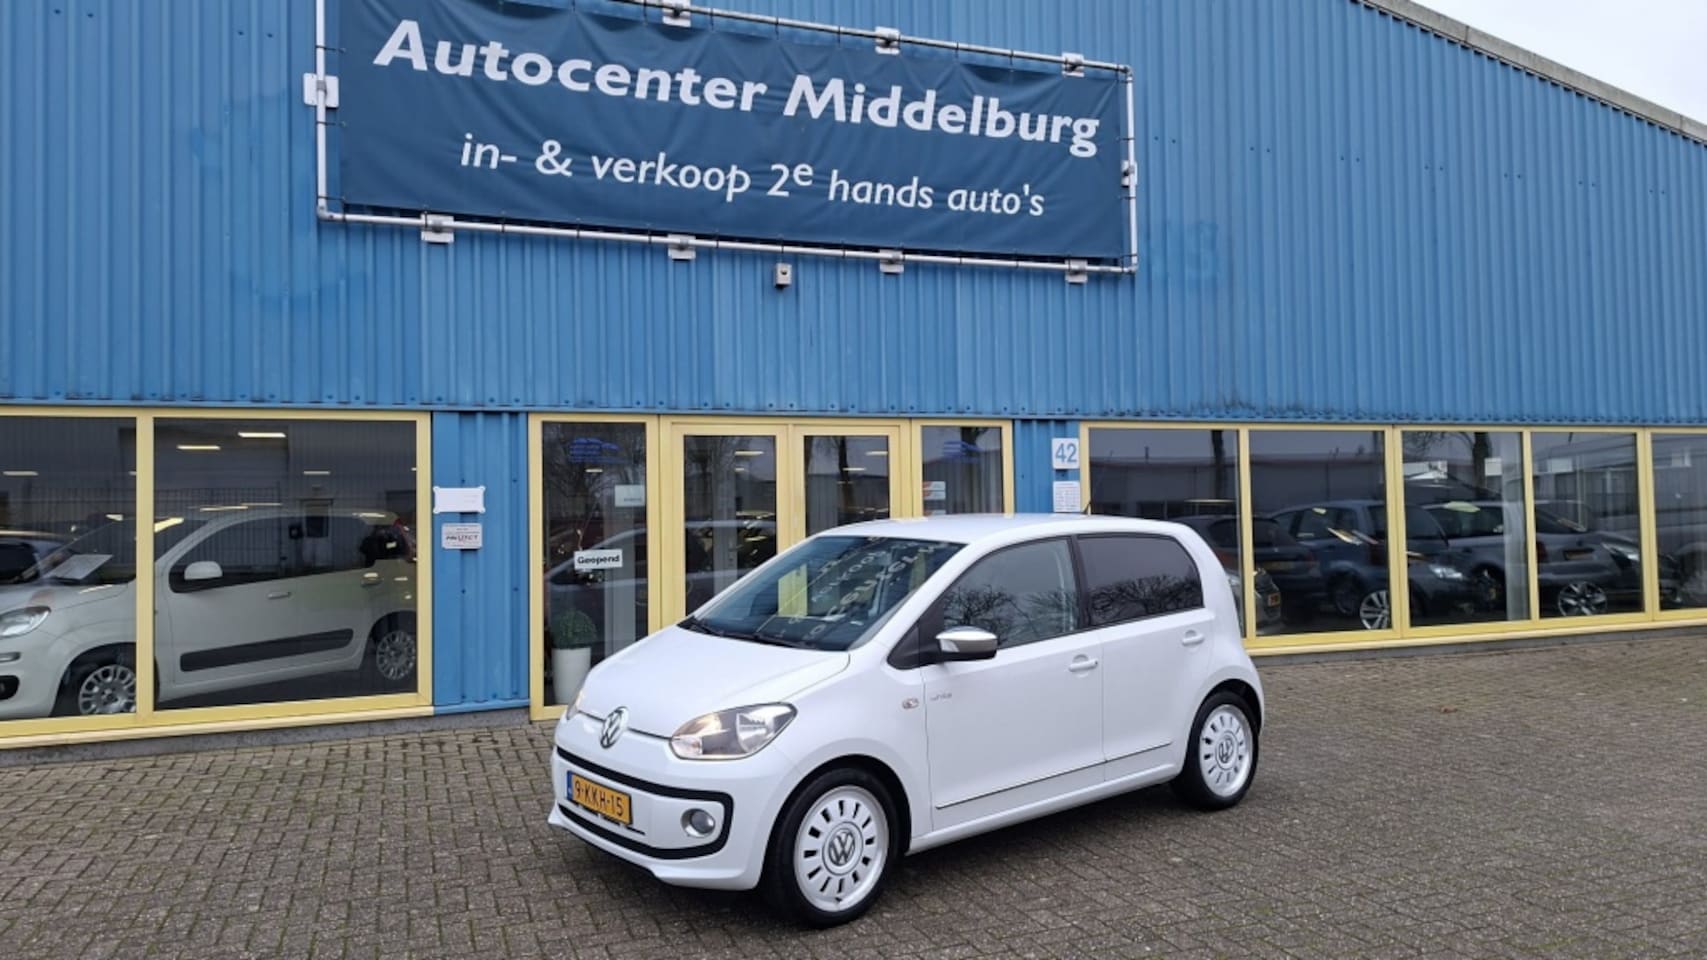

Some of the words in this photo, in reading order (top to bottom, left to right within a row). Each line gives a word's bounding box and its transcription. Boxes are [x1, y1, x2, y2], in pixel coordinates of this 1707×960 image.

[374, 20, 768, 111] Autocenter
[784, 74, 1100, 158] Middelburg
[462, 134, 516, 168] in-
[536, 140, 572, 176] &
[592, 152, 750, 201] verkoop
[829, 170, 933, 208] hands
[948, 184, 1043, 215] auto's
[1055, 443, 1077, 463] 42
[577, 555, 620, 565] Geopend
[575, 780, 624, 817] 9-KKH-15
